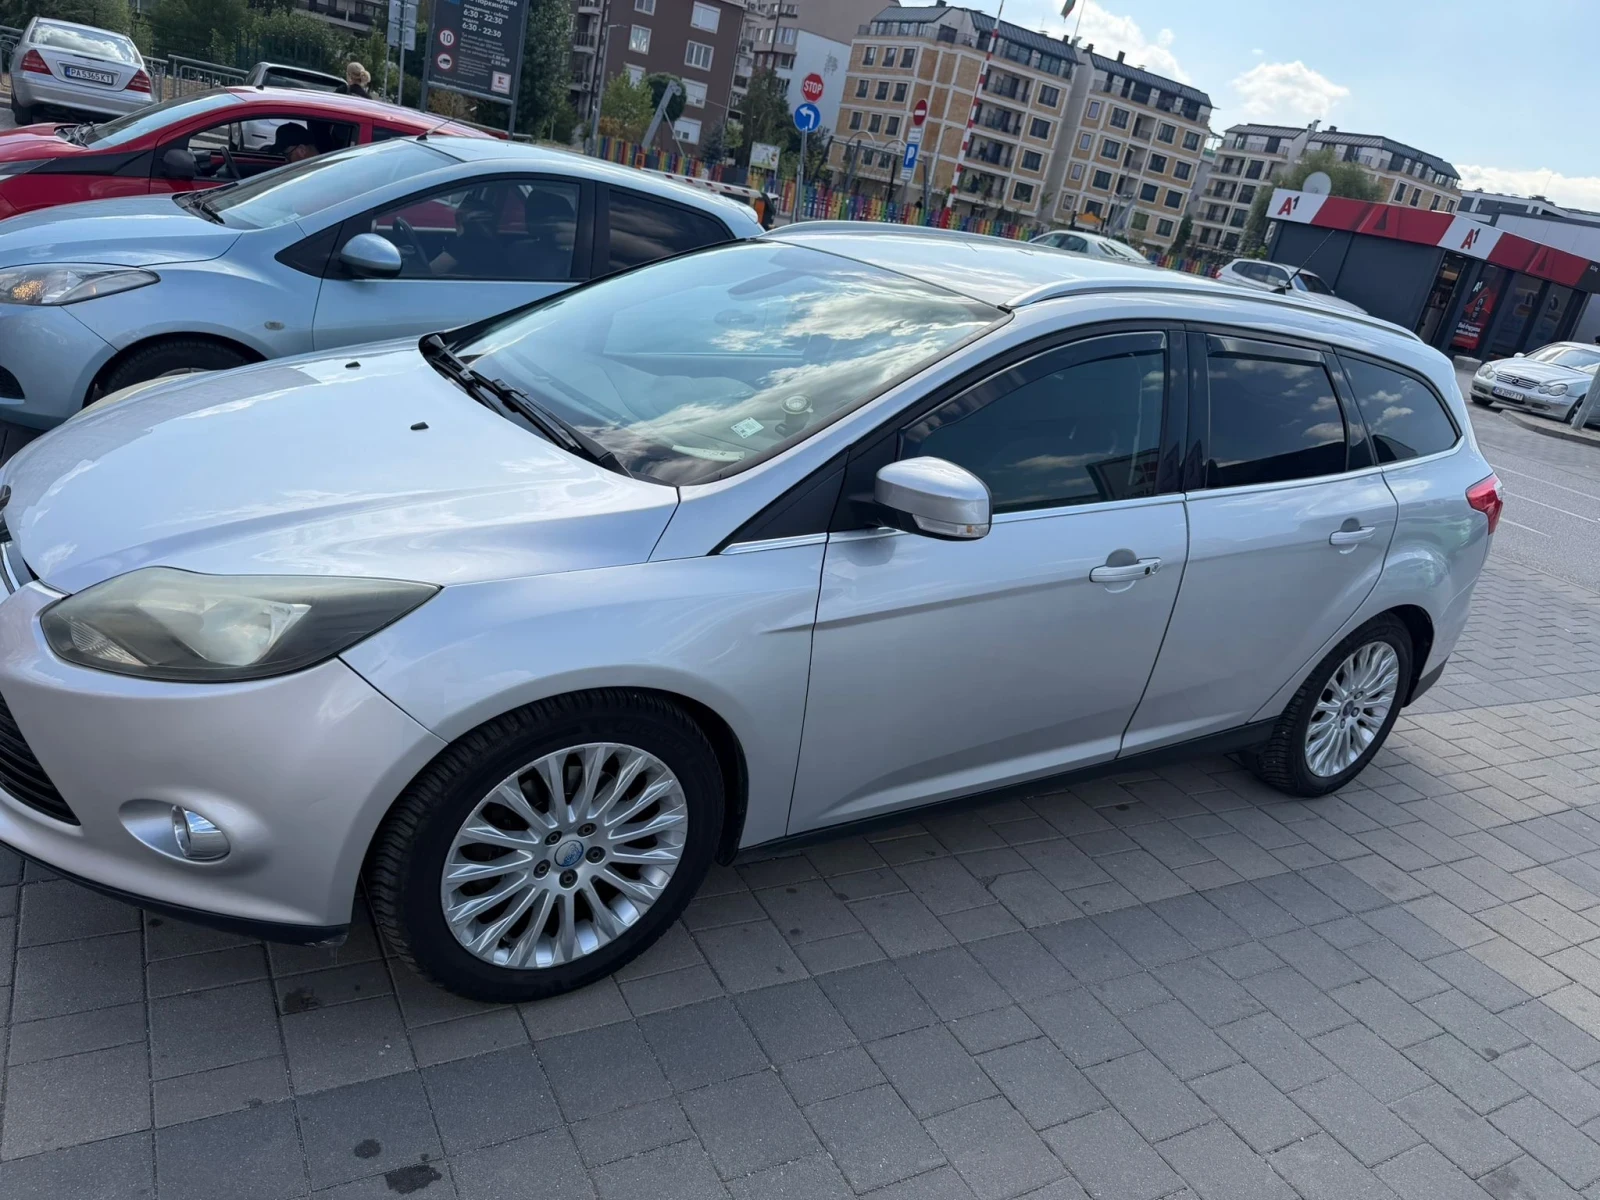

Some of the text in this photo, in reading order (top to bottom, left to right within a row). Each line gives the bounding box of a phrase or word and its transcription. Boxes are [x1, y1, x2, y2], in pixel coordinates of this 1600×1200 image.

[463, 8, 479, 18] 6:30
[483, 14, 503, 25] 22:30
[442, 32, 452, 43] 10
[462, 22, 477, 31] 6:30
[482, 27, 502, 38] 22:30
[803, 80, 823, 95] STOP
[905, 146, 915, 166] P
[1277, 195, 1300, 216] A1
[1460, 228, 1482, 250] A1
